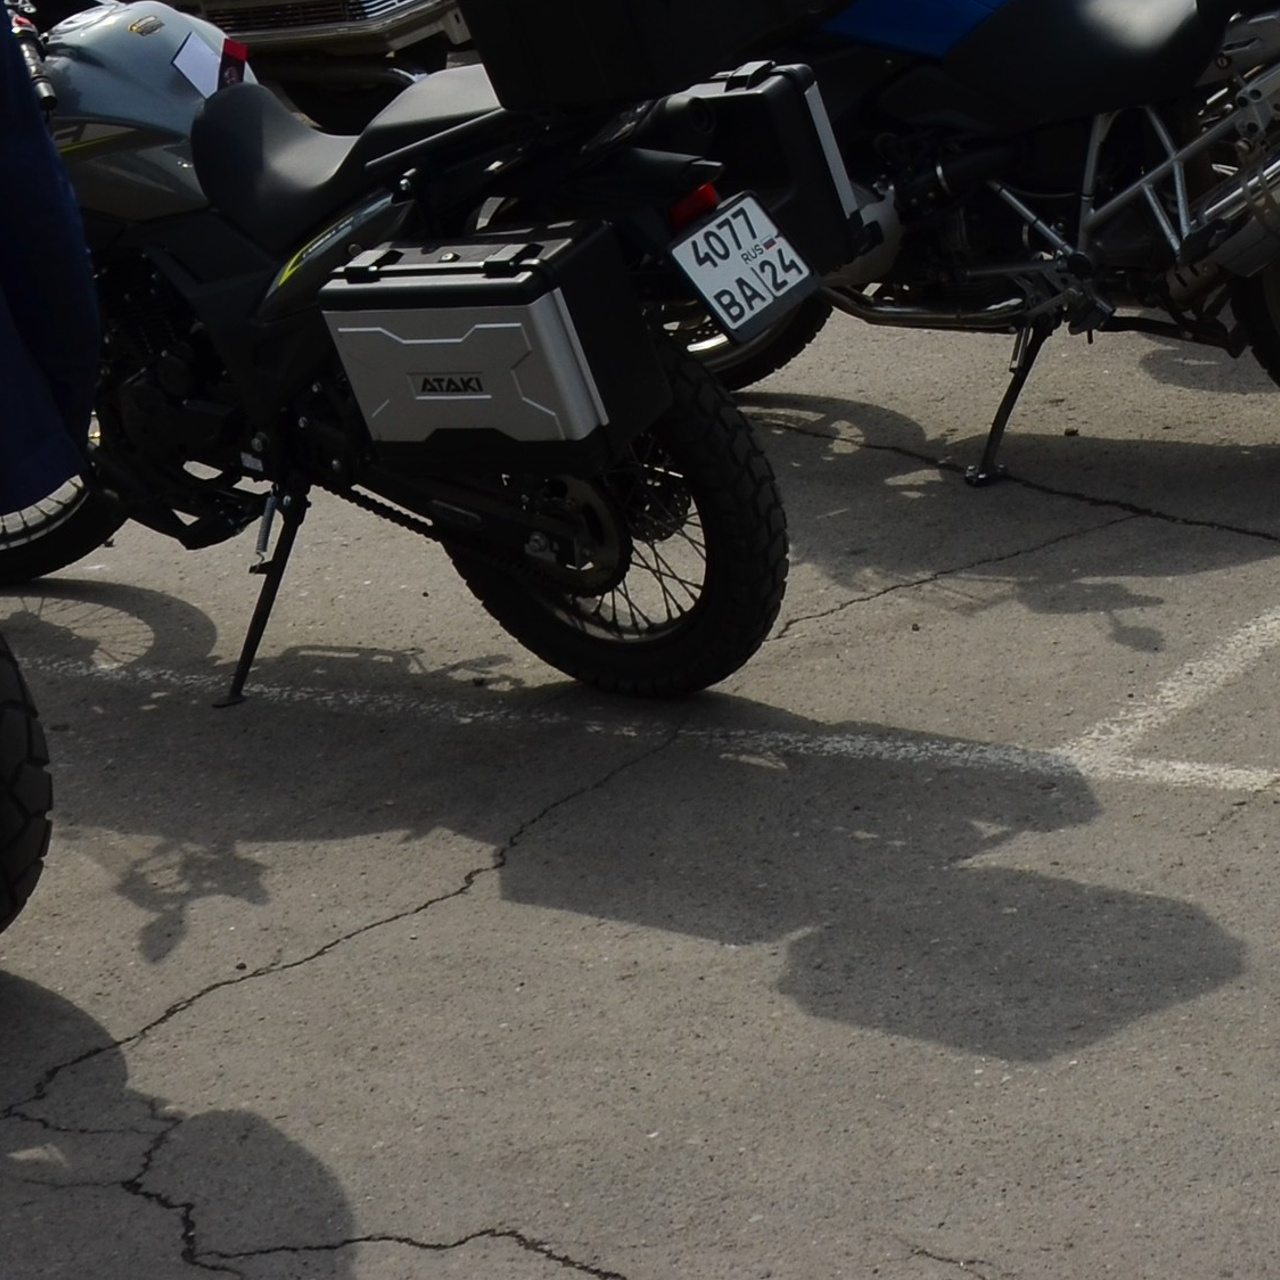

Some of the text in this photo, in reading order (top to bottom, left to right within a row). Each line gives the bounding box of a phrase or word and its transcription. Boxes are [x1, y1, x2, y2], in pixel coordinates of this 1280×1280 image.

[691, 206, 758, 268] 4077
[740, 244, 764, 264] RUS
[713, 248, 803, 323] BA 24
[421, 377, 484, 392] ATAKI
